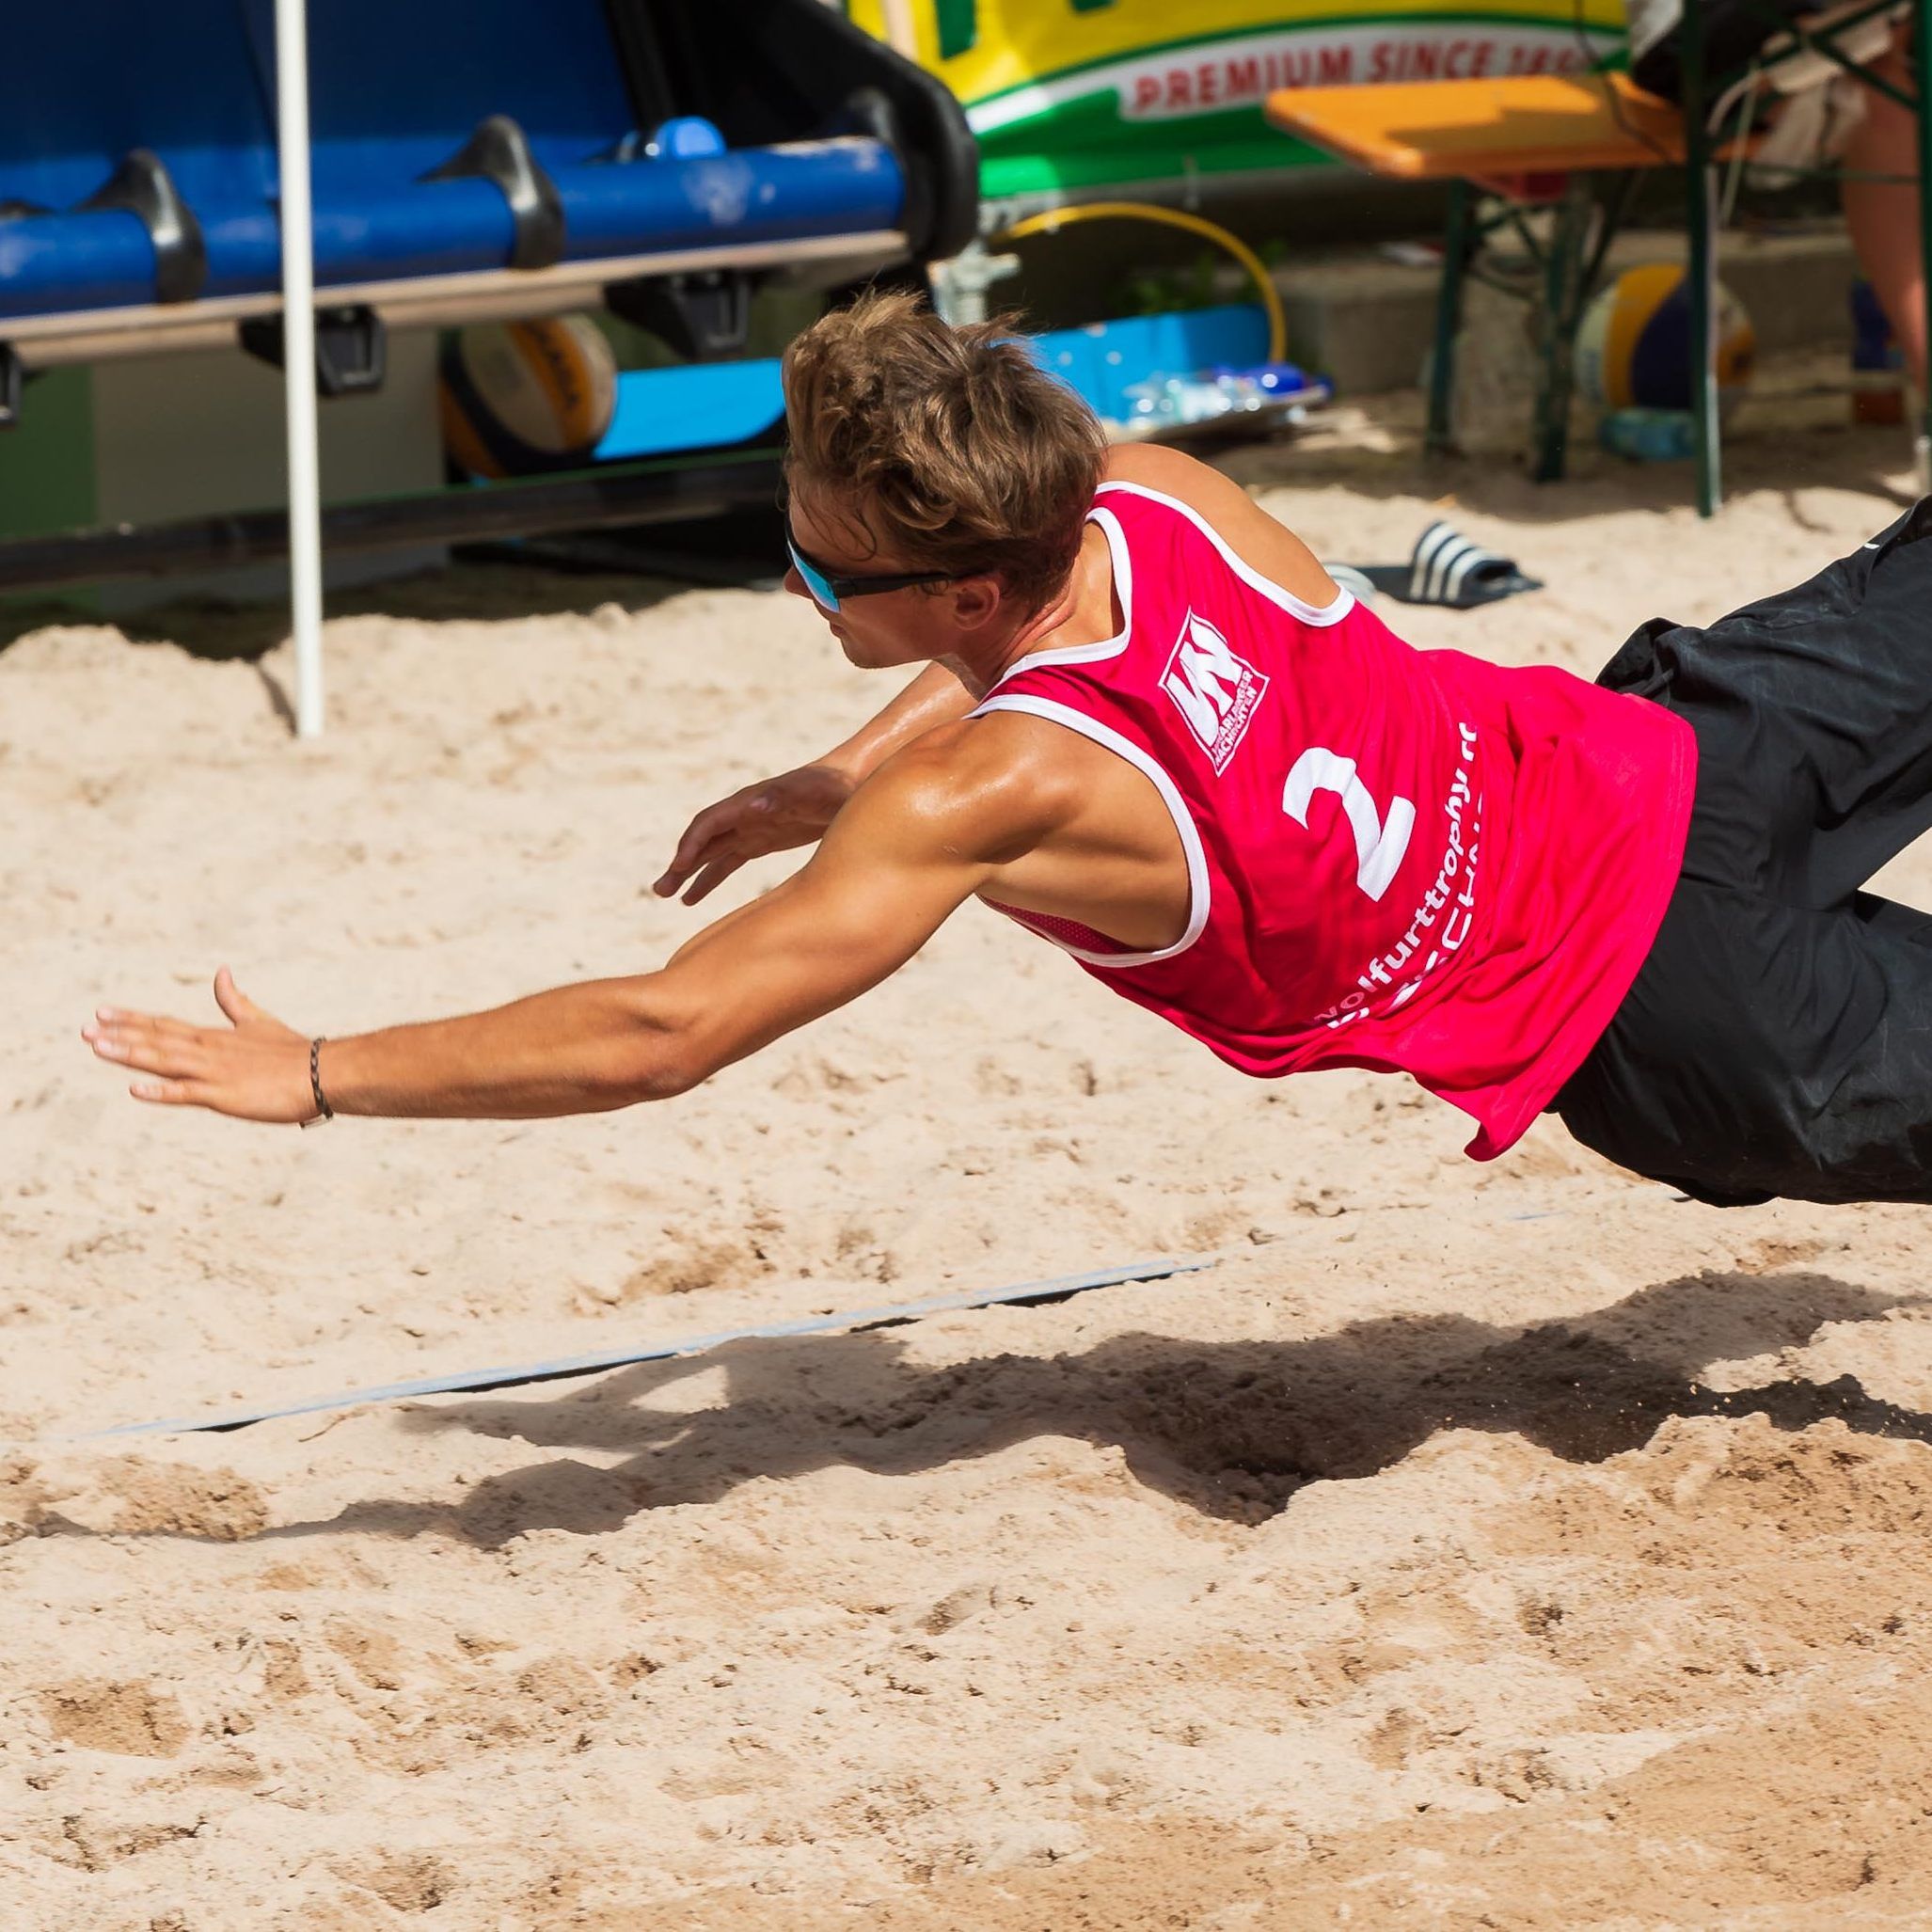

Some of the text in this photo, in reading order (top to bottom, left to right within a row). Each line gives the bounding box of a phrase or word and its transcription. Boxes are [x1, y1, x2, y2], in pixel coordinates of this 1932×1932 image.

[1132, 43, 1354, 115] PREMIUM
[1366, 38, 1497, 83] SINCE
[1282, 747, 1417, 902] 2
